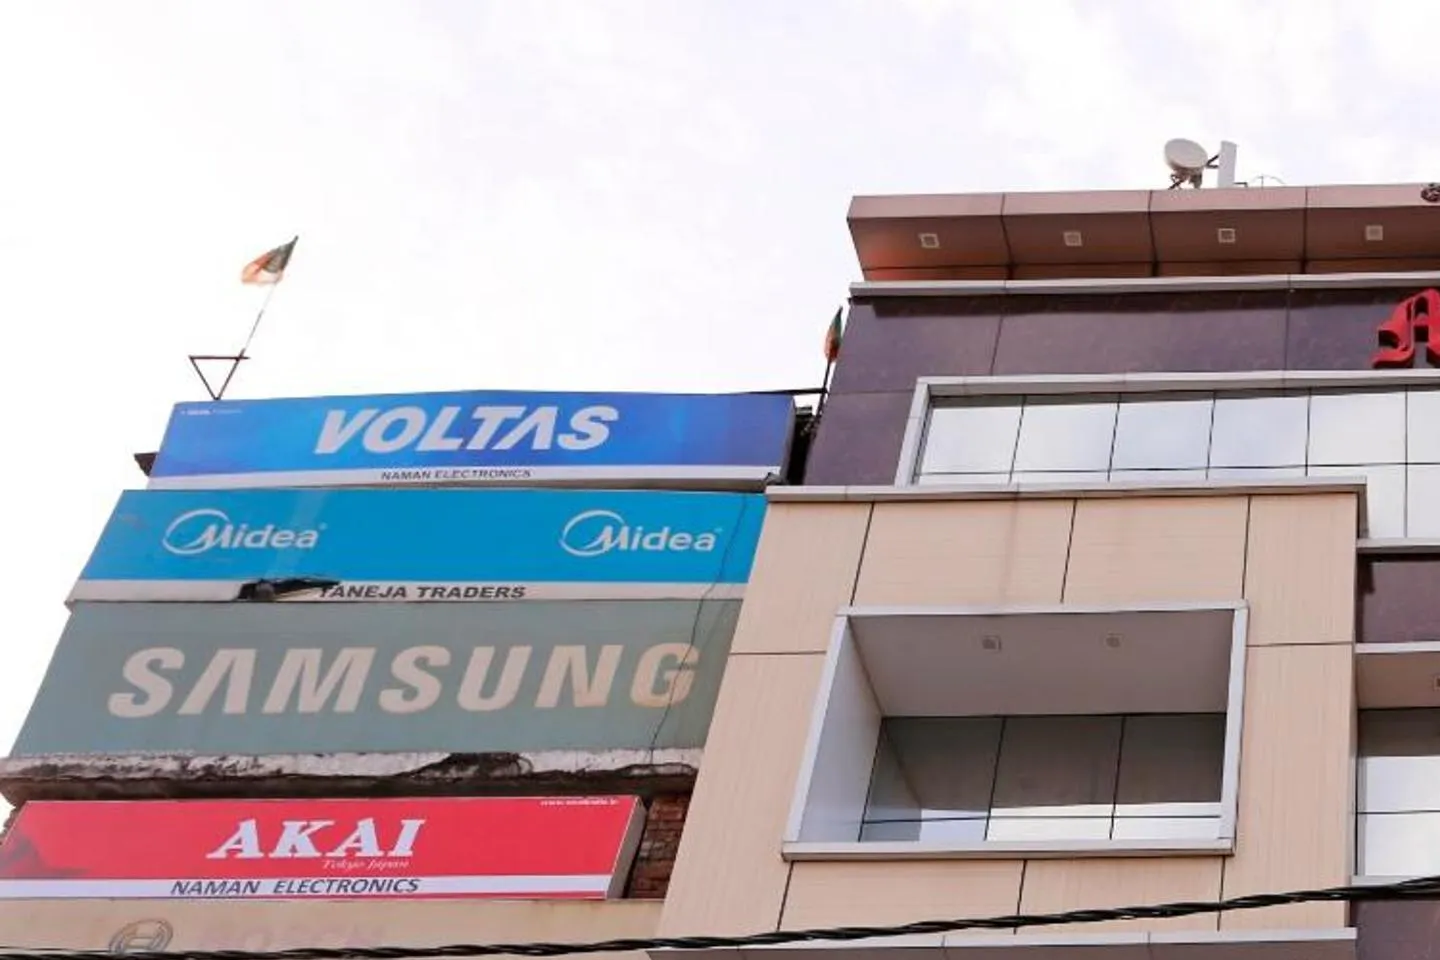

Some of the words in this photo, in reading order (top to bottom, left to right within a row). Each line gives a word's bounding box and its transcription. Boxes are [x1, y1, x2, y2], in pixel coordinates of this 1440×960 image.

[314, 405, 619, 455] VOLTAS
[381, 470, 430, 481] NAMAN
[434, 468, 531, 480] ELECTRONICS
[319, 585, 407, 599] TANEJA
[416, 586, 526, 599] TRADERS
[107, 642, 700, 719] SAMSUNG
[205, 817, 426, 859] AKAI
[170, 880, 260, 896] NAMAN
[272, 878, 420, 894] ELECTRONICS
